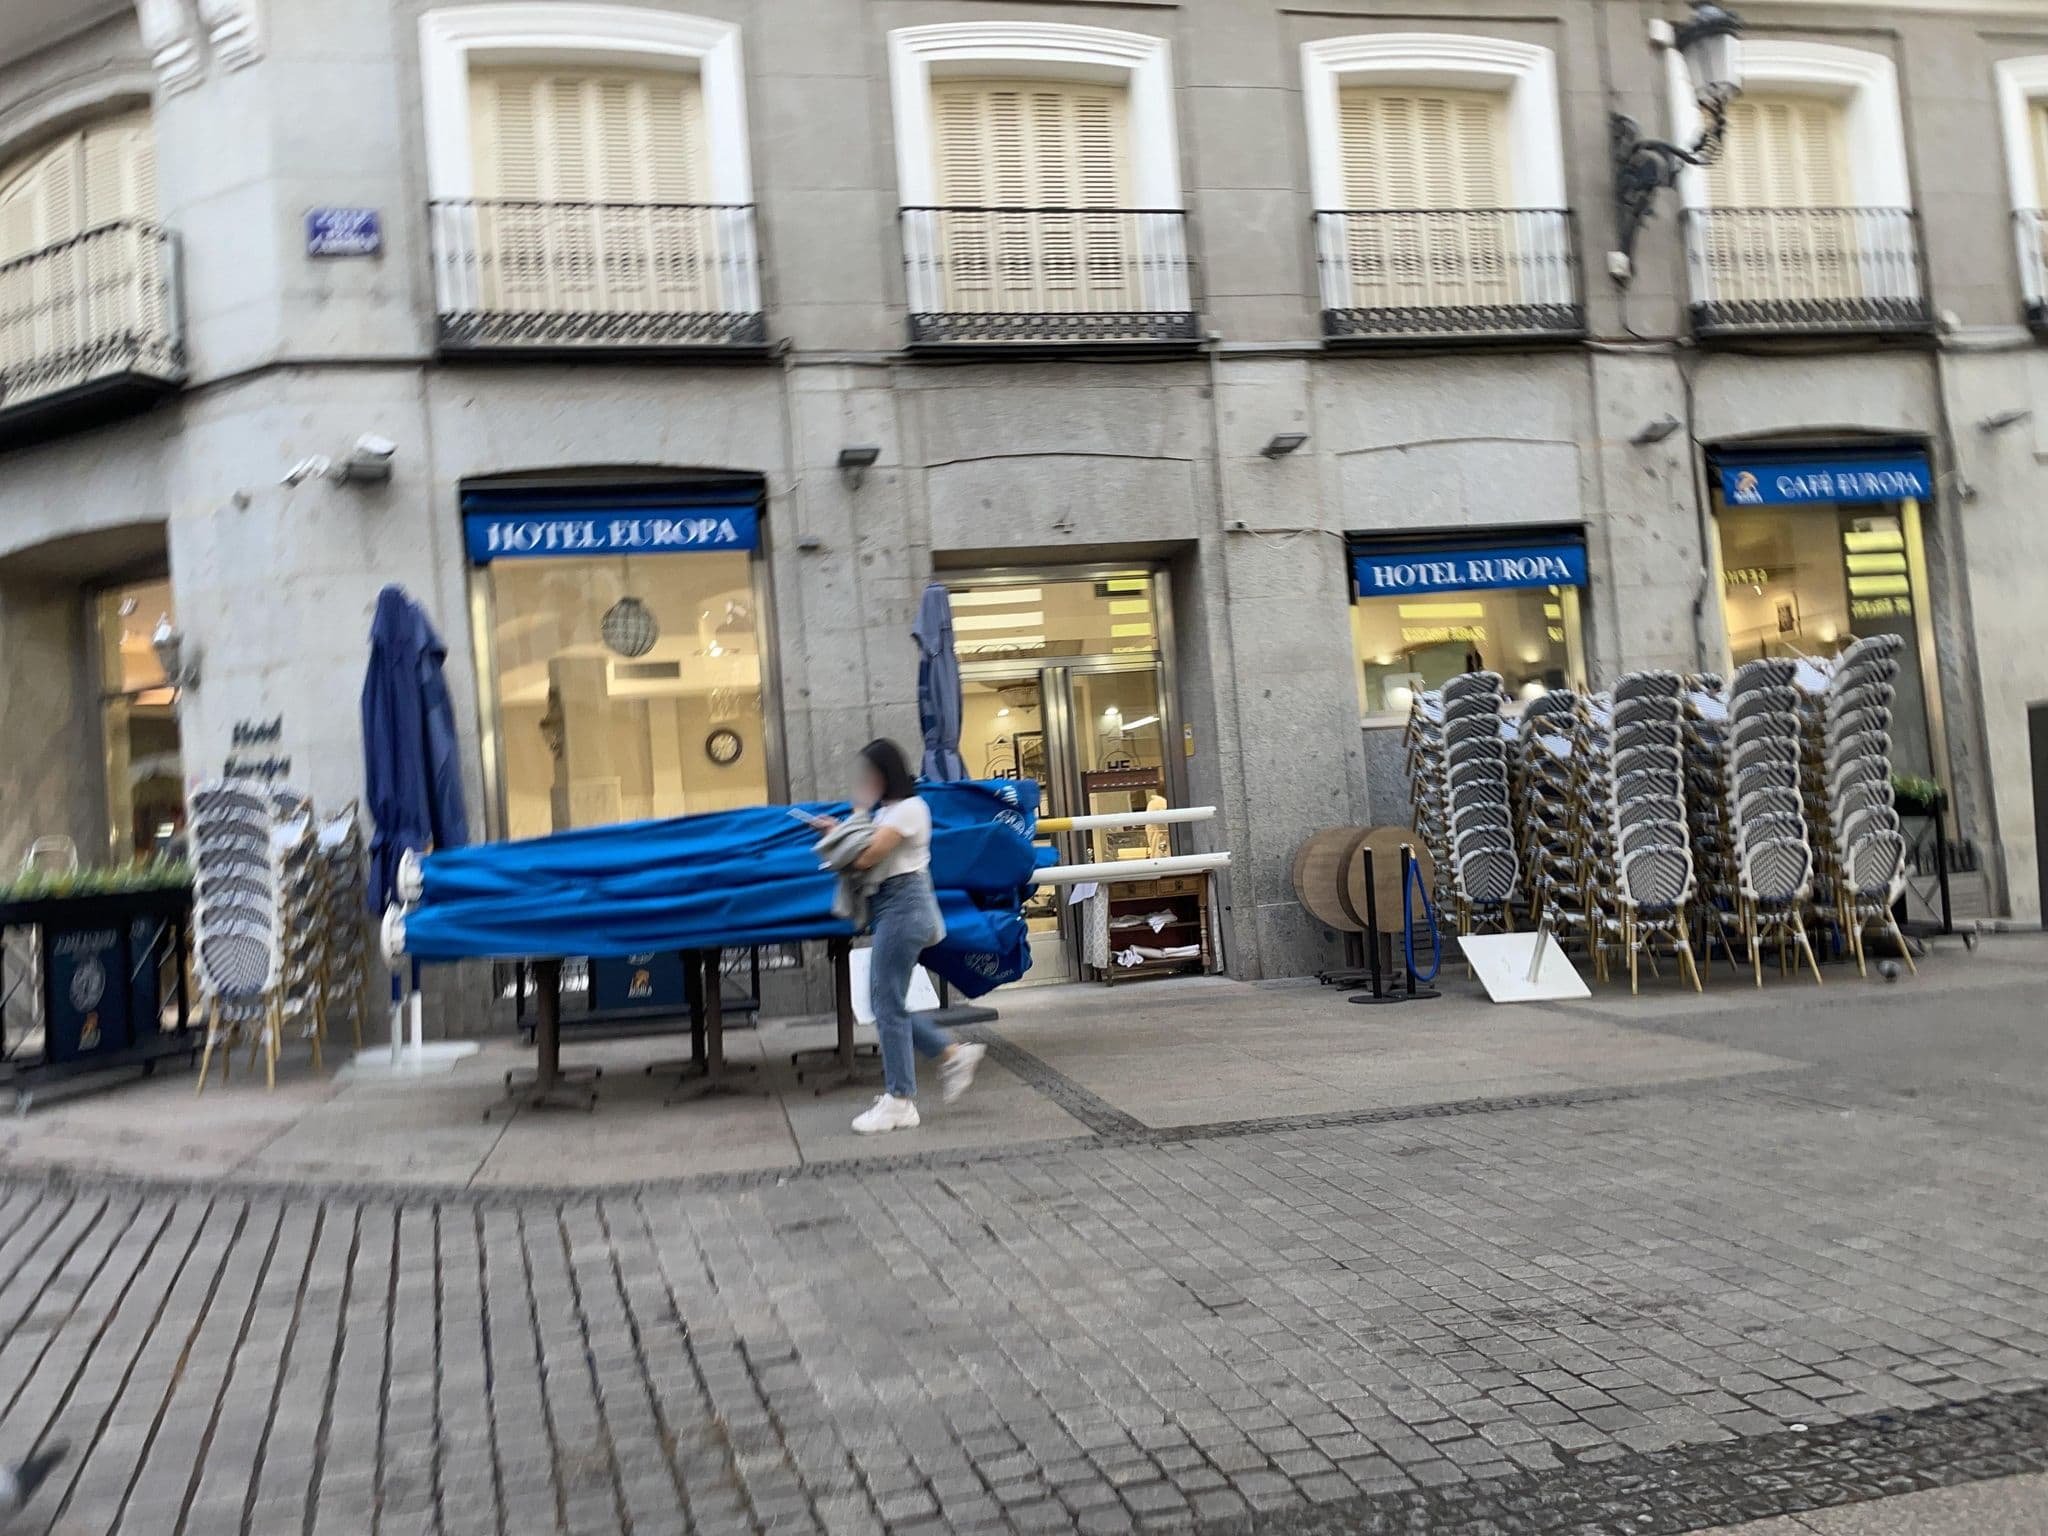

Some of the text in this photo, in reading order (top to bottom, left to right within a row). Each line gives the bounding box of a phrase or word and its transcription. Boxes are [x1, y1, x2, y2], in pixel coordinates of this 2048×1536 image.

[486, 517, 739, 551] HOTEL EUROPA
[1373, 556, 1572, 587] HOTEL EUROPA
